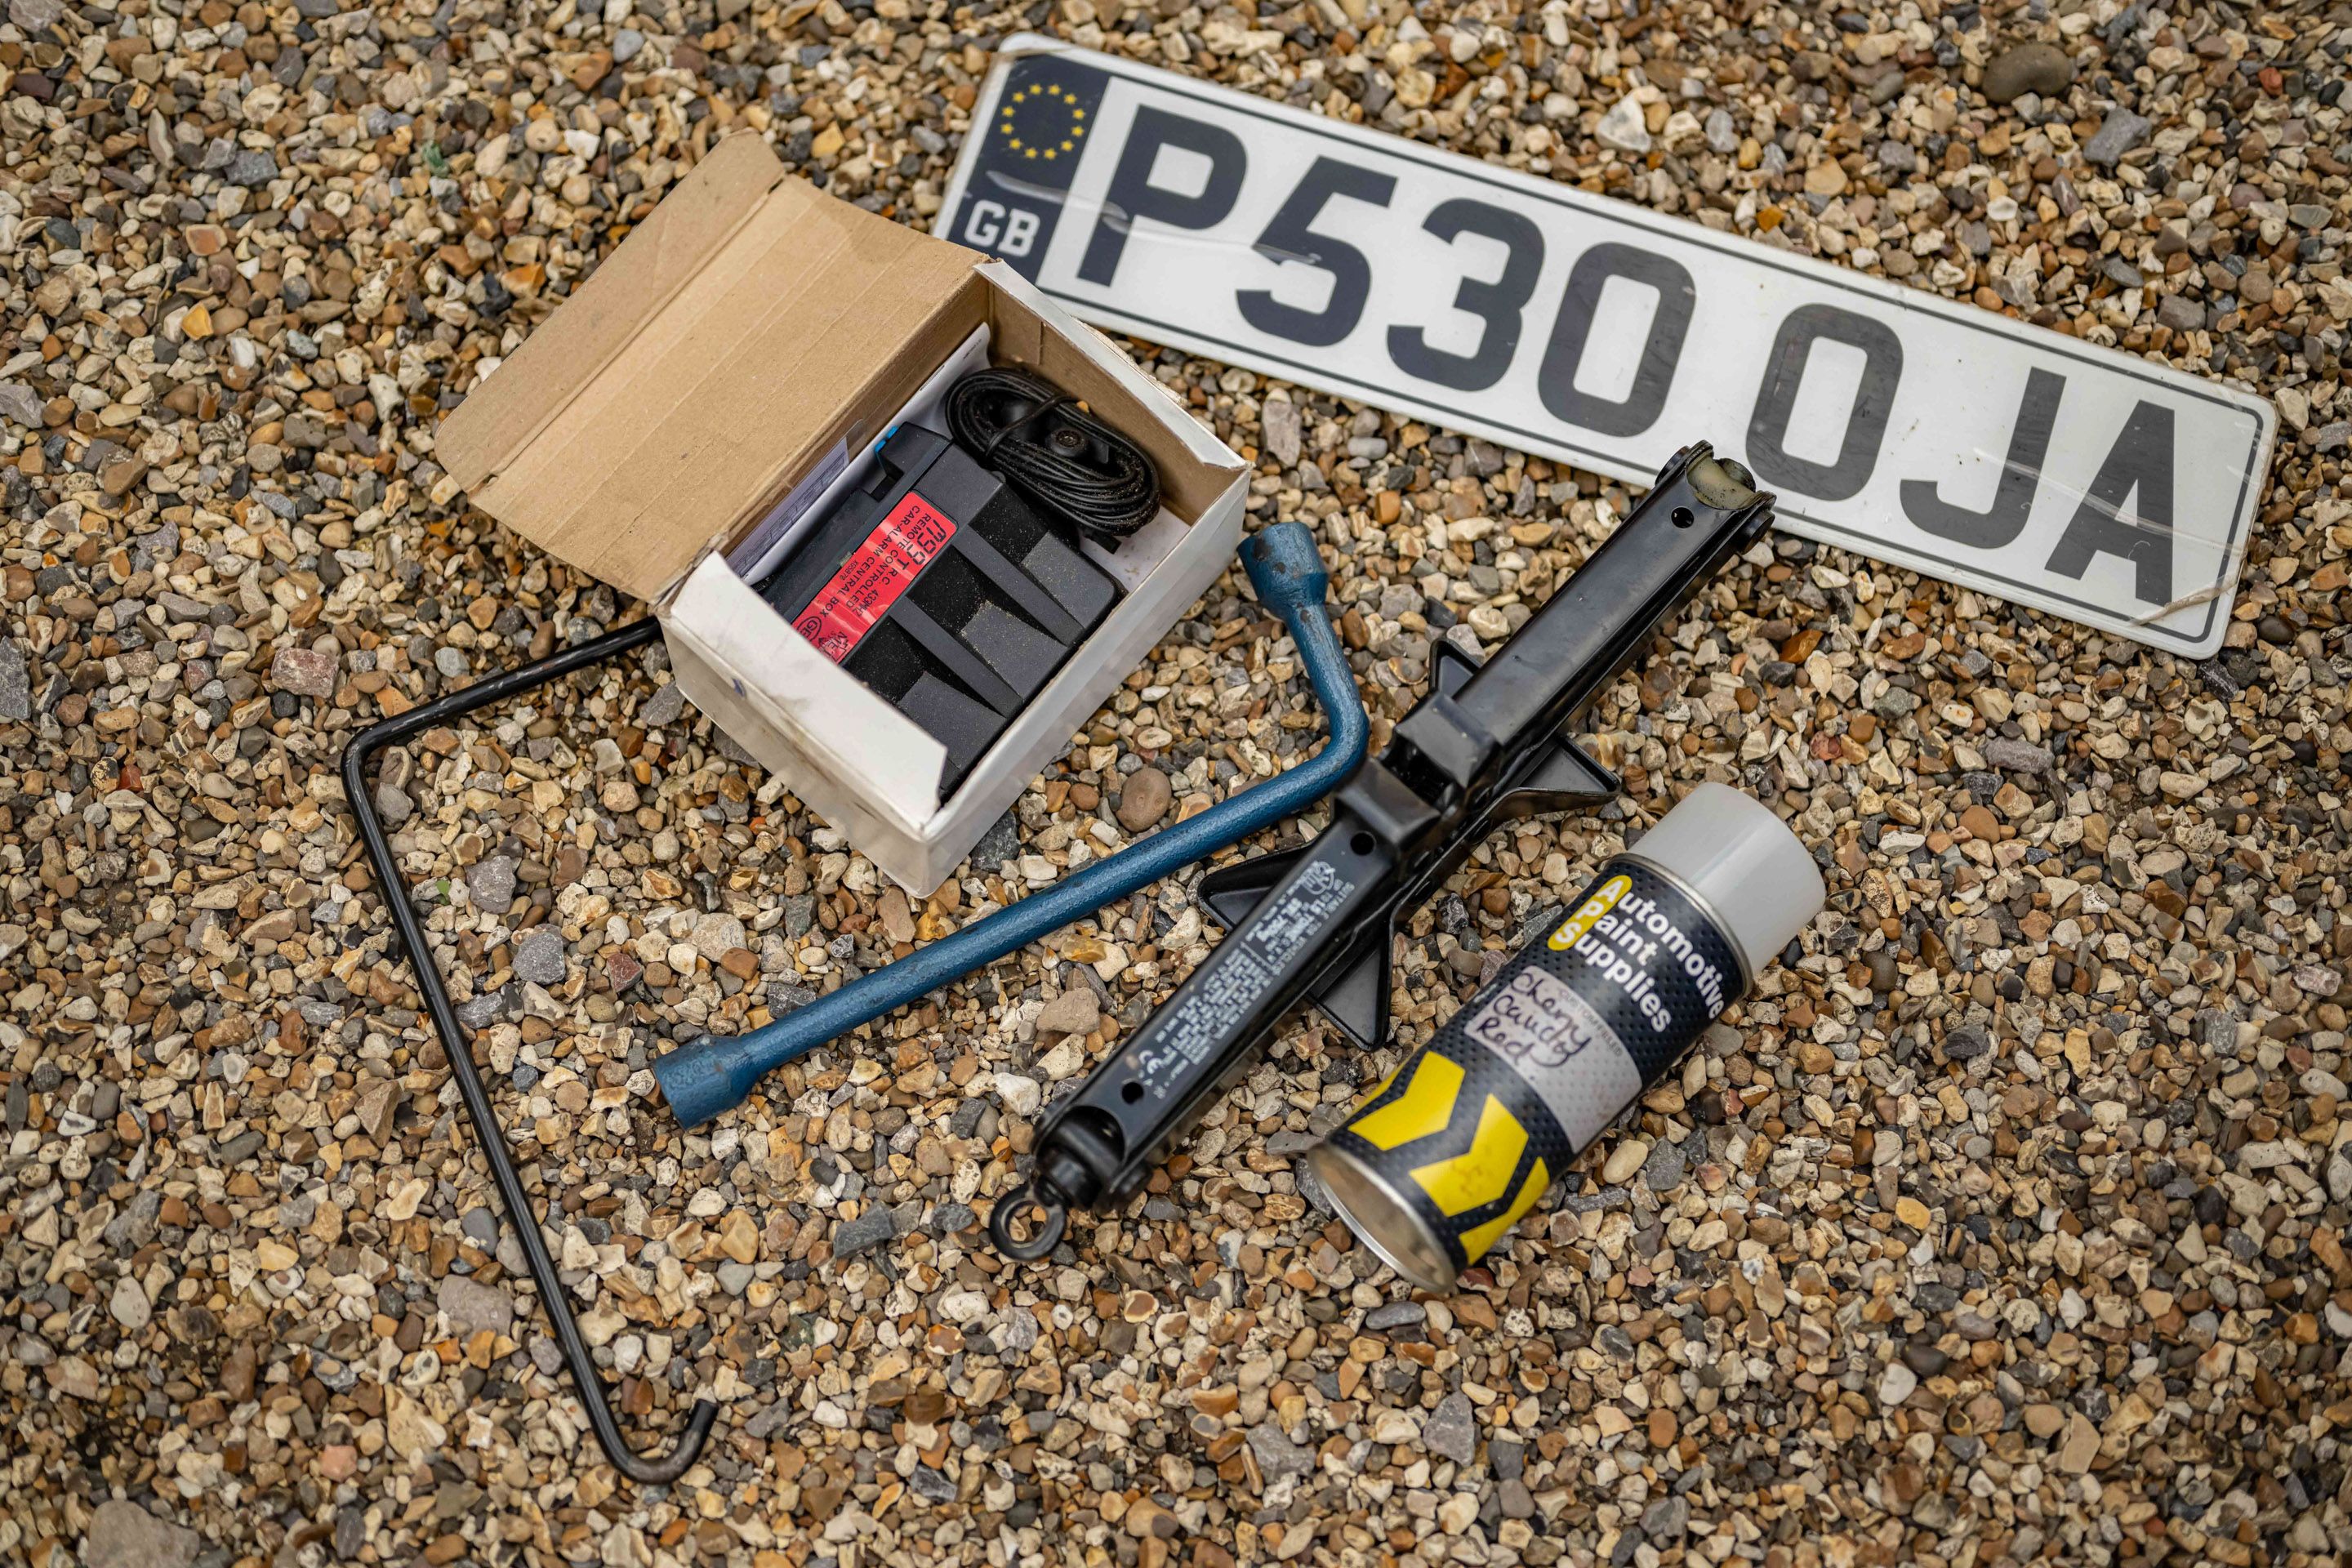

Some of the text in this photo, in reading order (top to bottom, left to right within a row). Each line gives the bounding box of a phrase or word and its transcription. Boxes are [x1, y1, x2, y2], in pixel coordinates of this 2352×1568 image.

[964, 200, 1041, 257] GB
[1076, 105, 2176, 606] P530 OJA
[844, 512, 931, 609] REMOTE CONTROLLED
[872, 503, 920, 557] CAR-ALARM
[818, 595, 840, 617] BOX
[836, 555, 875, 598] CENTRAL
[1575, 900, 1658, 966] Paint
[1595, 879, 1726, 1019] Automotive
[1555, 921, 1672, 1034] Supplies
